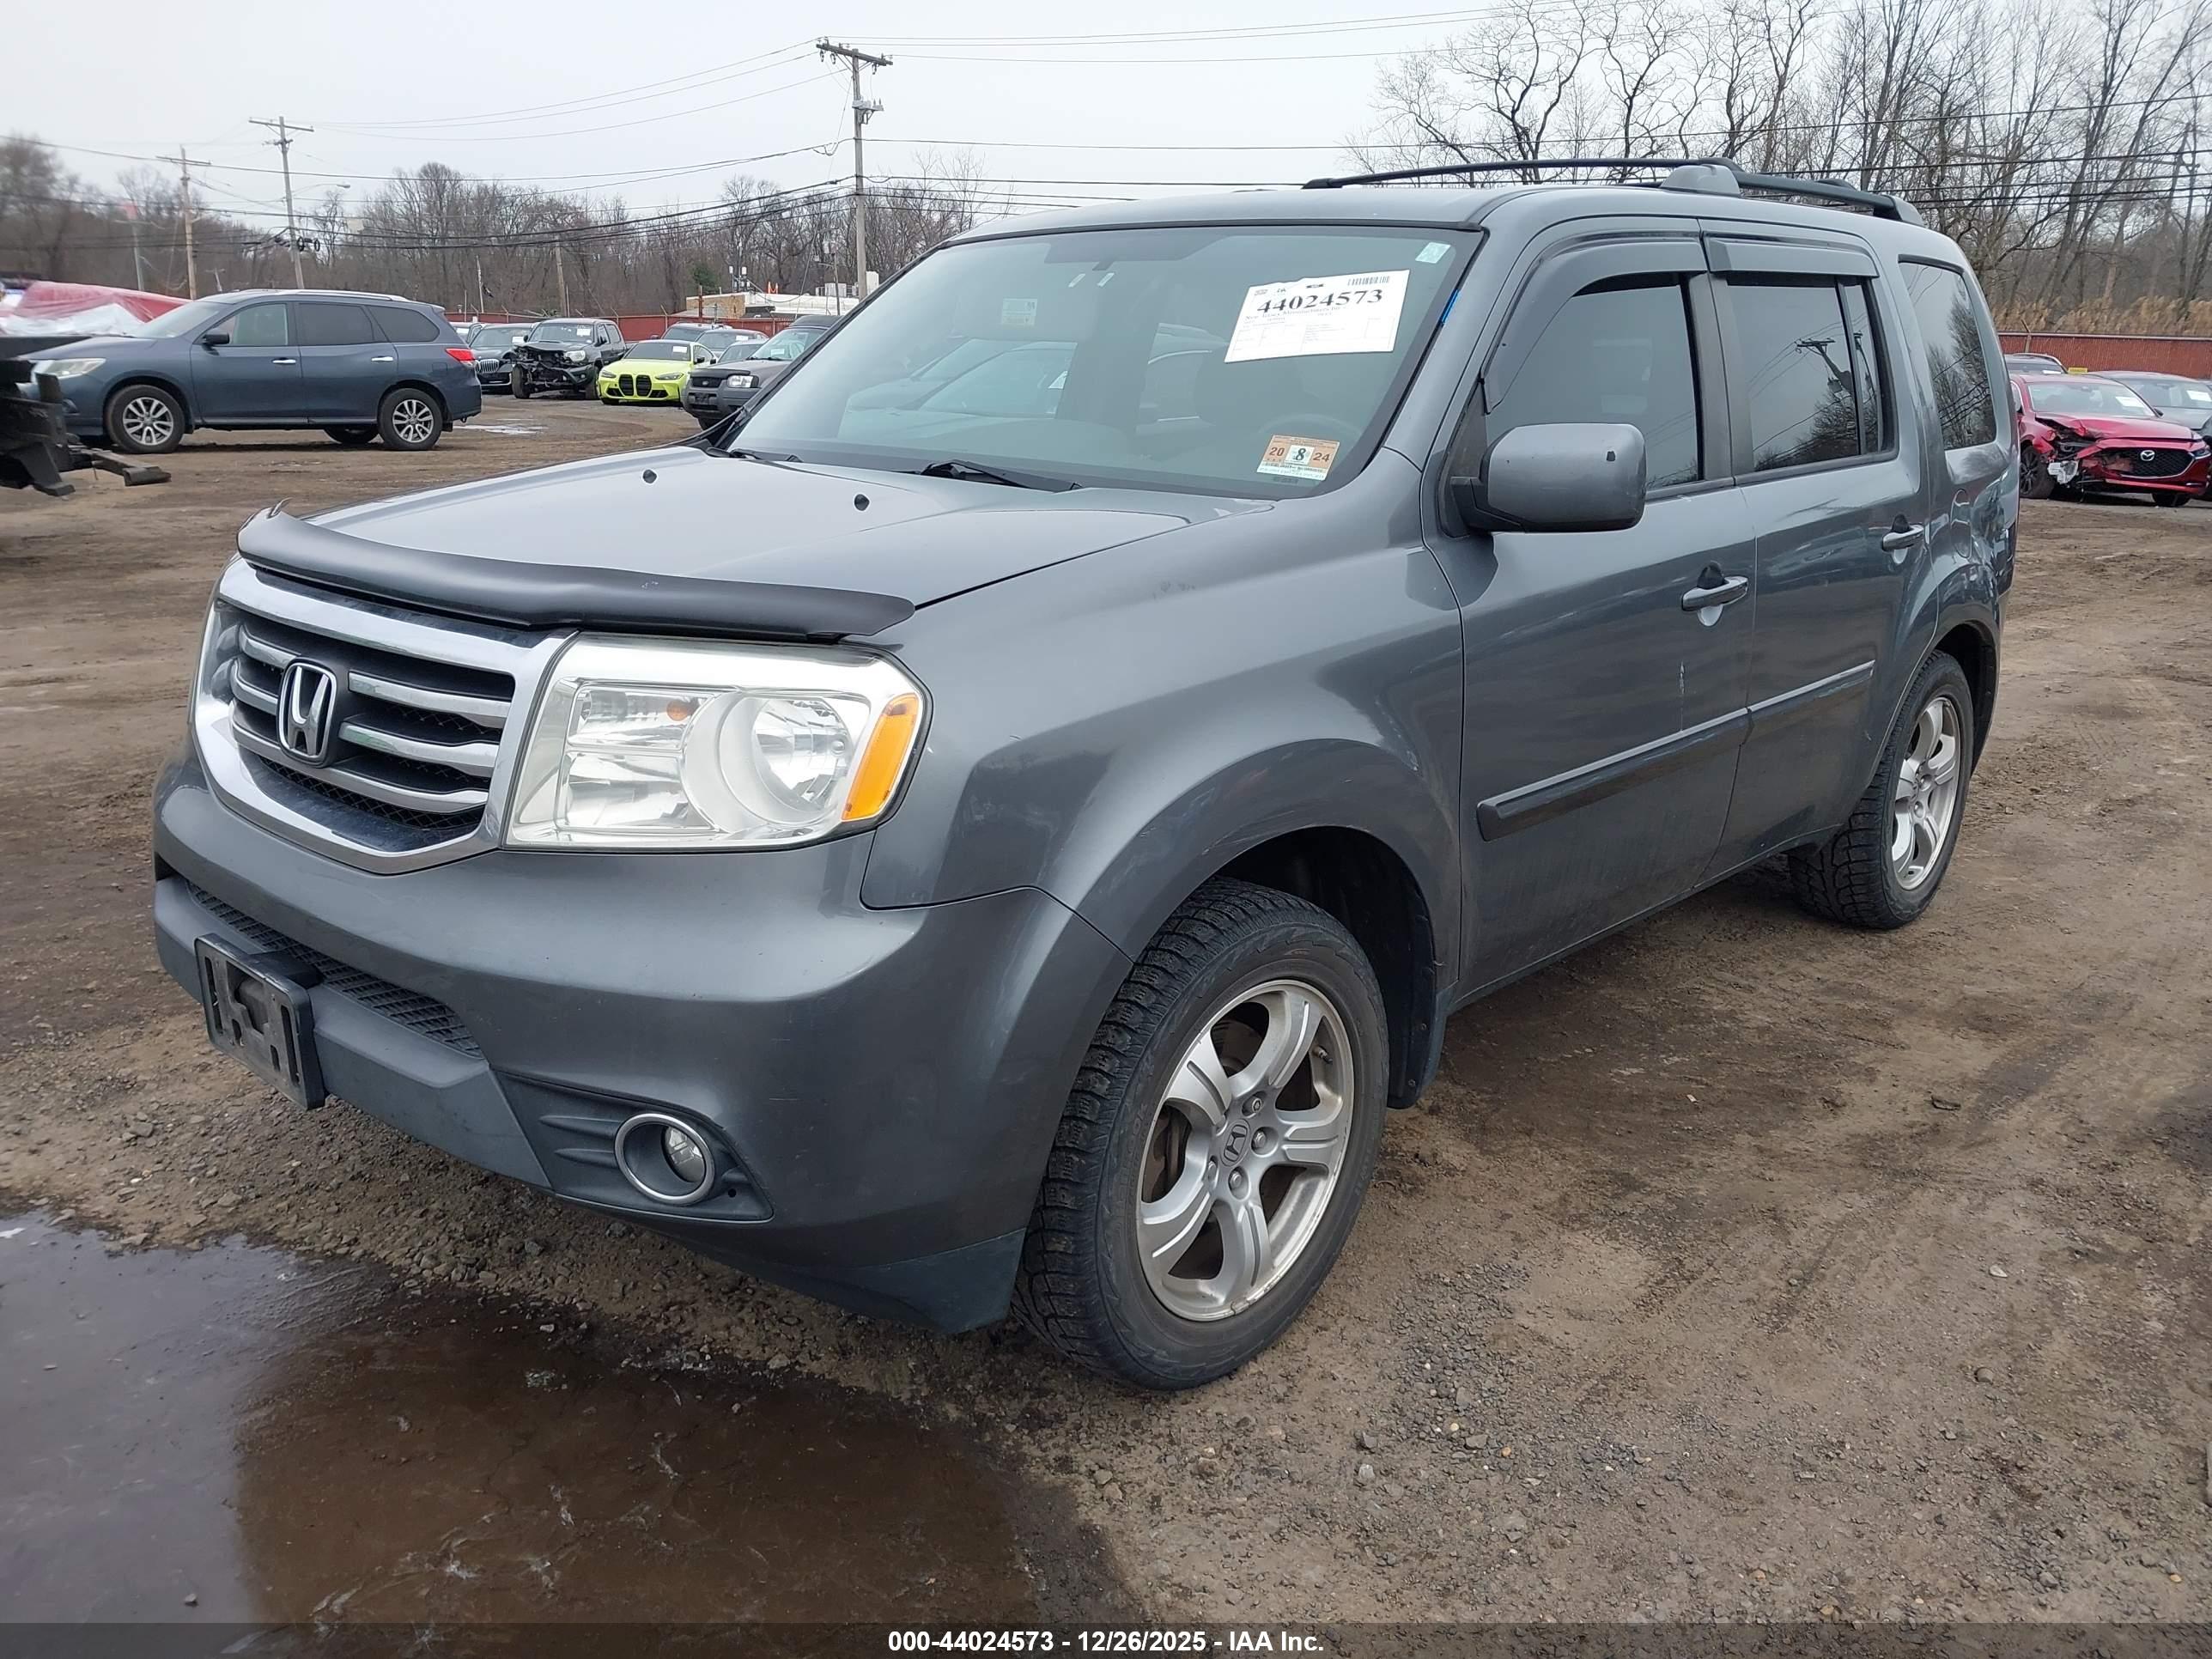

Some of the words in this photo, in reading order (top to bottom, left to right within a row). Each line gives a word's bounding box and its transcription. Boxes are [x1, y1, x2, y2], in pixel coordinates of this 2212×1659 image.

[1256, 289, 1382, 313] 44024573
[1269, 447, 1285, 457] 20
[1295, 447, 1306, 461] 8
[1313, 452, 1330, 462] 24
